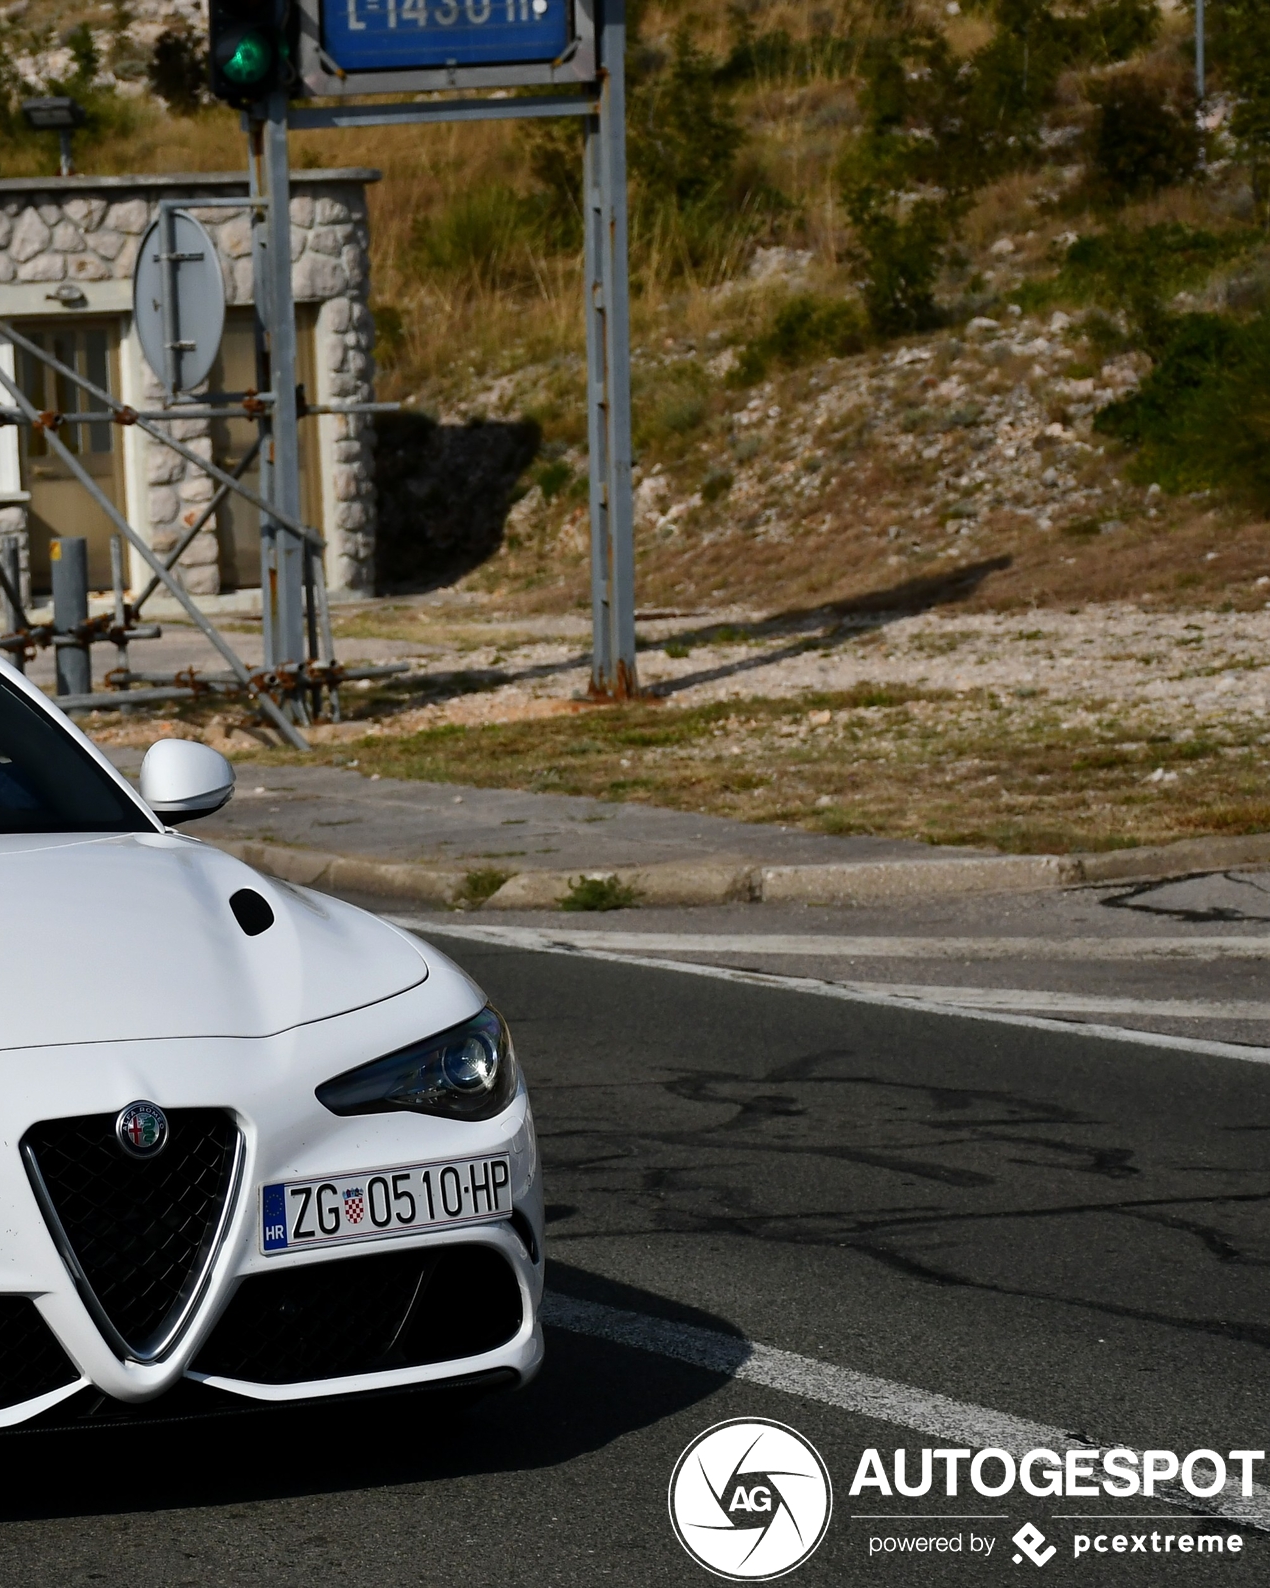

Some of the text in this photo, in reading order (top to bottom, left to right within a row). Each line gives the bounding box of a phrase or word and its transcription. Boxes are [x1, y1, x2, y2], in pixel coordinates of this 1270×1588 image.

[122, 1107, 165, 1132] ALFA ROMEO
[290, 1183, 341, 1240] ZG
[265, 1225, 285, 1241] HR
